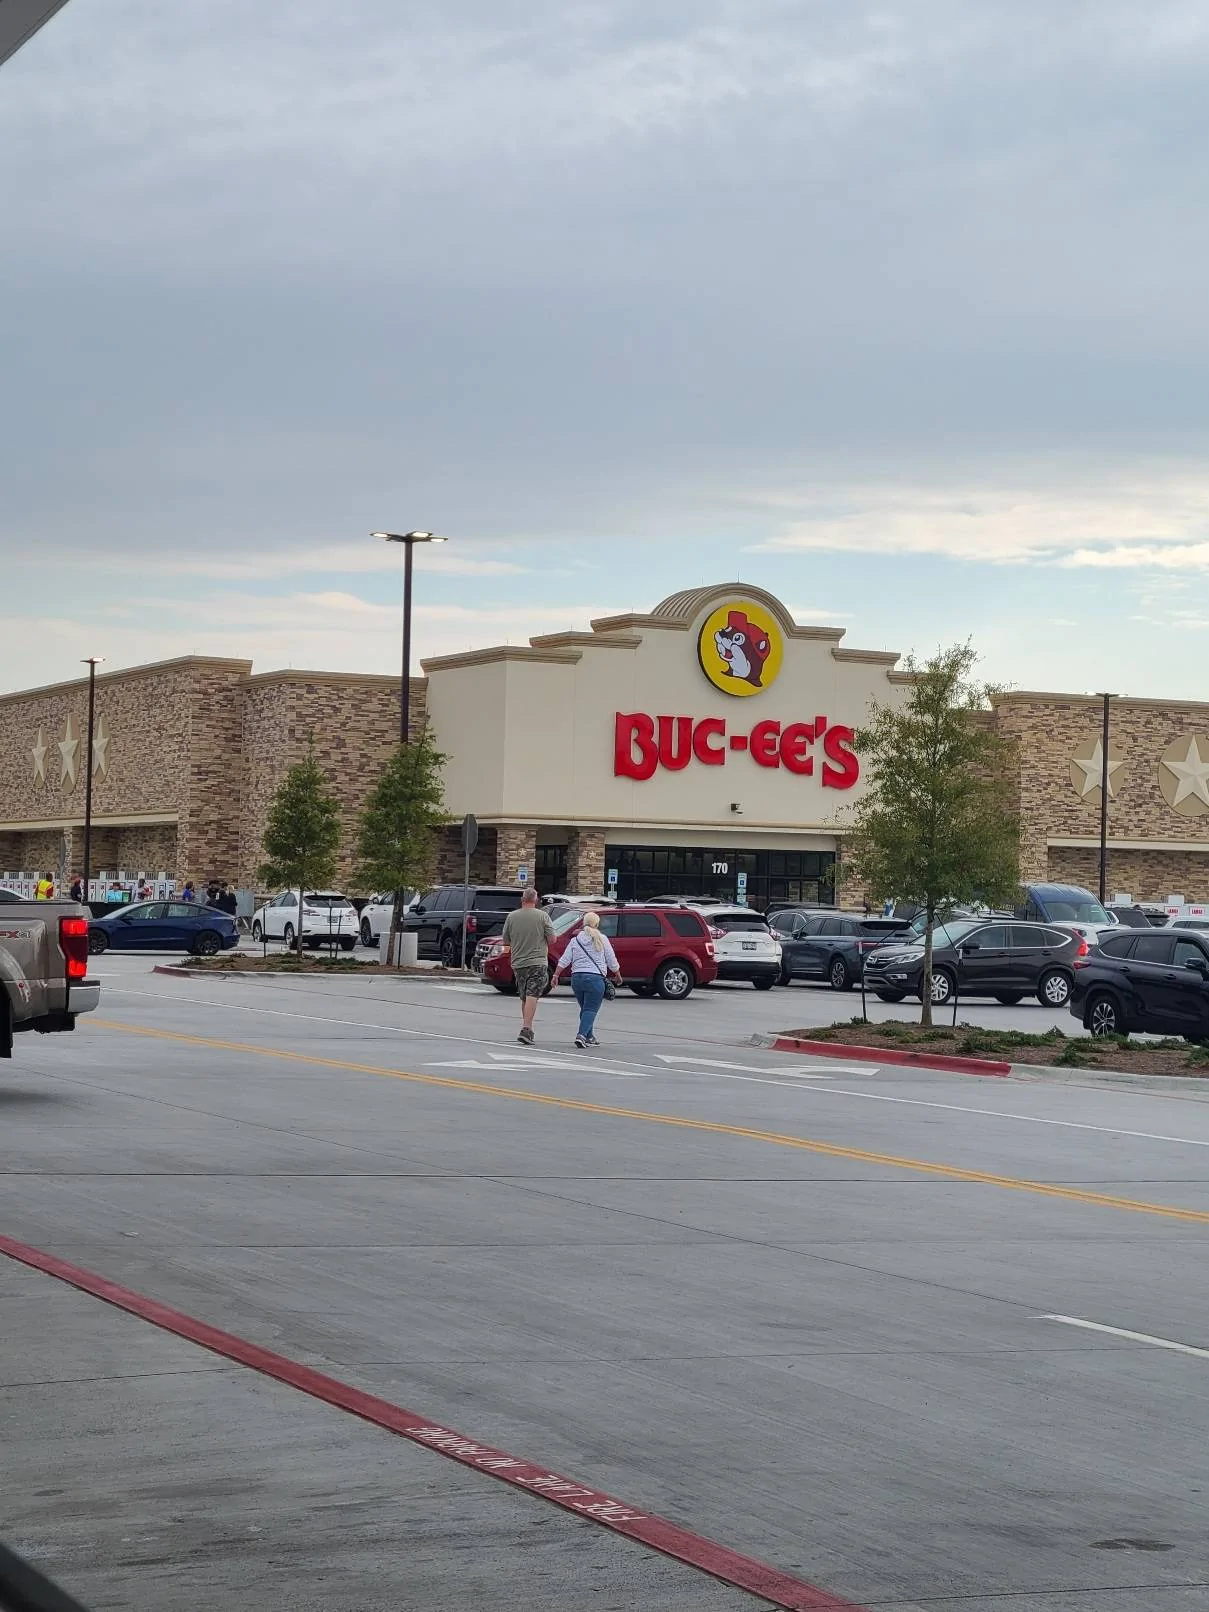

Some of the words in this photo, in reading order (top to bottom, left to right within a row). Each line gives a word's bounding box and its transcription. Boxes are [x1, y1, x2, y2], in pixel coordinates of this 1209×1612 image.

[711, 862, 729, 874] 170
[405, 1427, 496, 1455] PARKING
[475, 1456, 527, 1470] NO
[516, 1474, 594, 1498] LANE
[572, 1499, 647, 1522] FIRE
